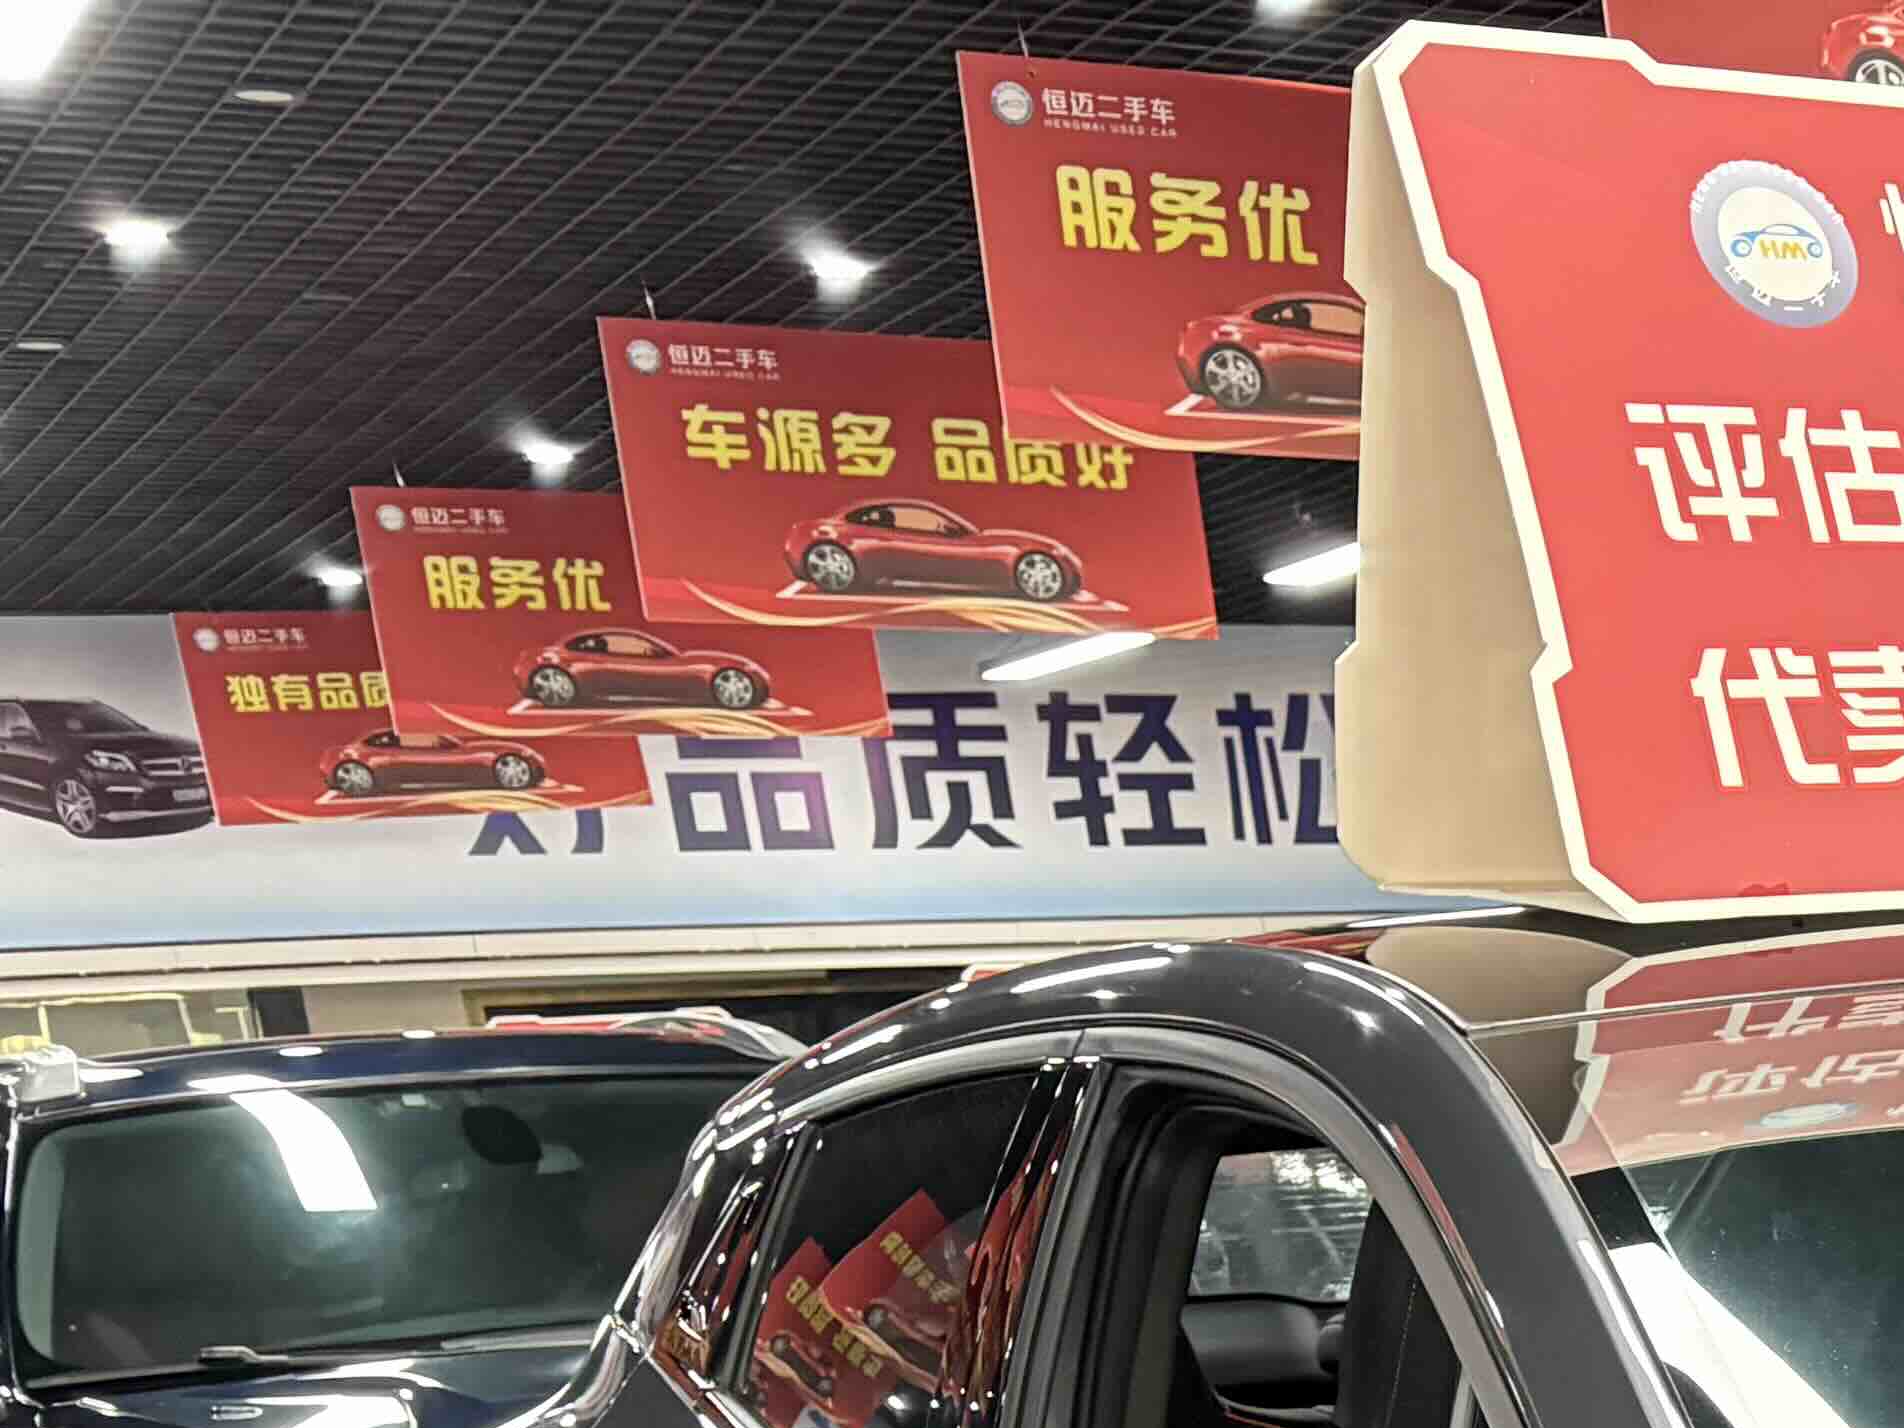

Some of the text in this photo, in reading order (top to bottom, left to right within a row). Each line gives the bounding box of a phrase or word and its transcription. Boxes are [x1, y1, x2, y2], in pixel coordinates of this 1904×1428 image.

[1042, 87, 1176, 125] 恒迈二手车
[1056, 164, 1319, 266] 服务优
[668, 343, 779, 371] 恒迈二手车
[680, 403, 1134, 491] 车源多 品质好
[423, 555, 611, 611] 服务优
[468, 690, 1338, 856] 品质轻松
